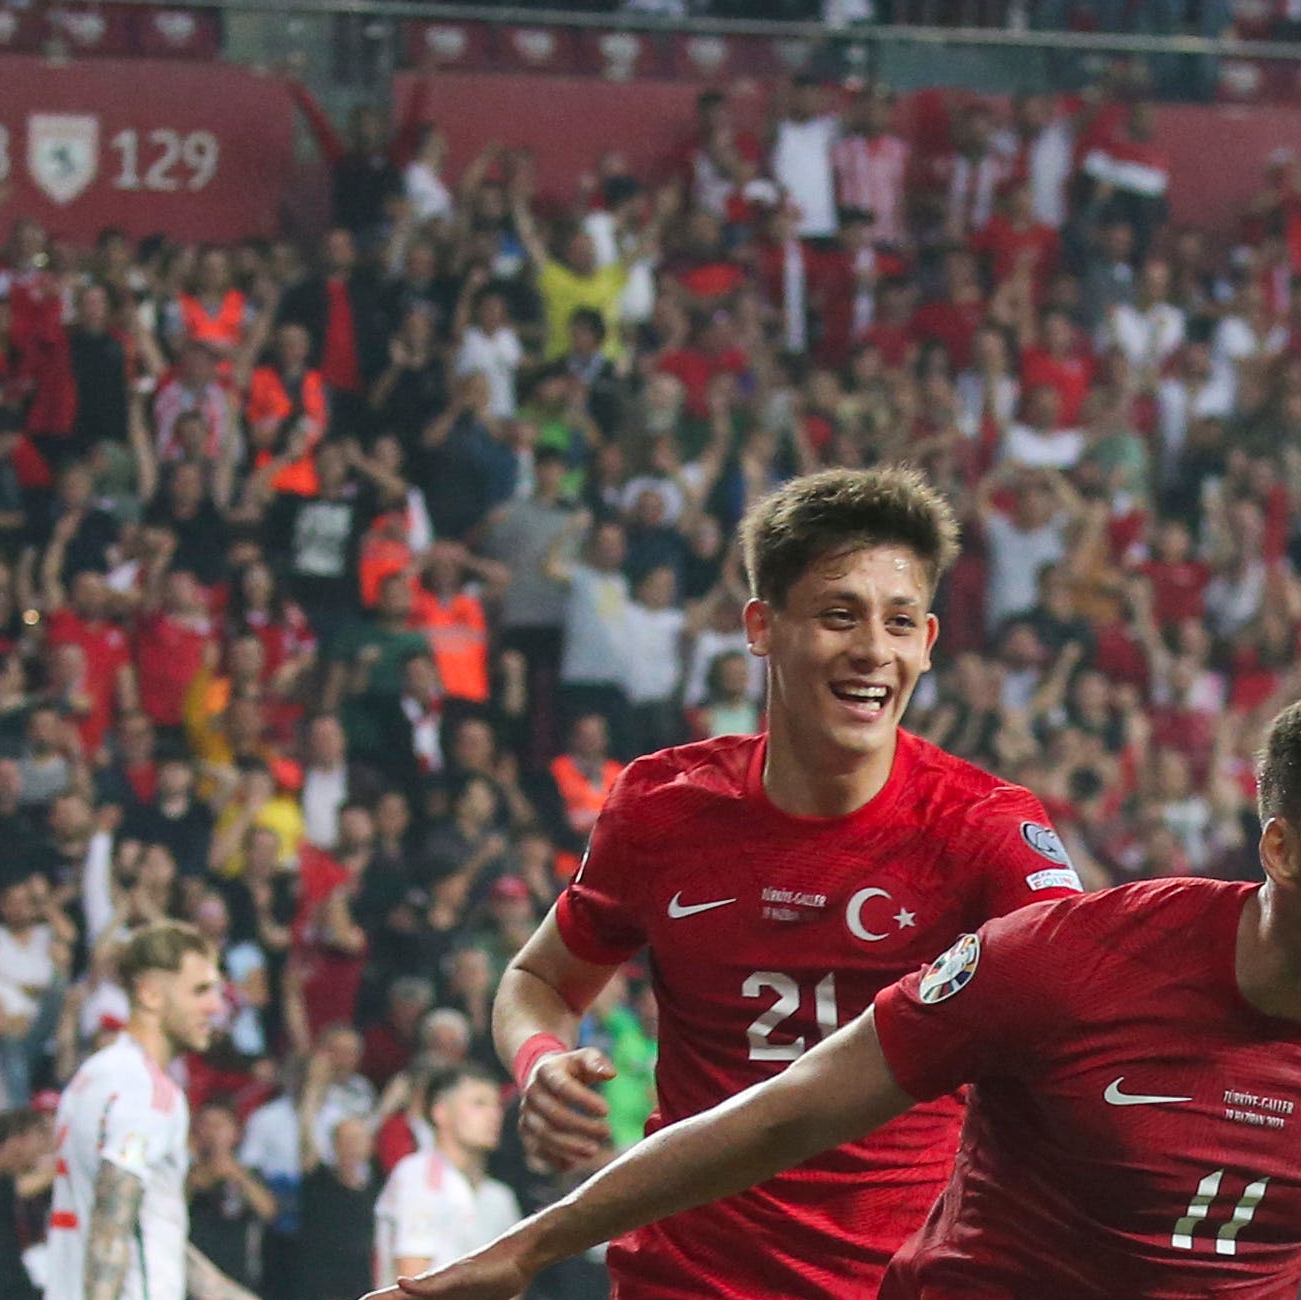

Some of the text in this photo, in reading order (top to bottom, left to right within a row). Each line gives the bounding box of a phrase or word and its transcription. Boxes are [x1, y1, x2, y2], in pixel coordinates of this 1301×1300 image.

[111, 128, 220, 191] 129
[741, 970, 839, 1062] 21
[1171, 1167, 1271, 1256] 11
